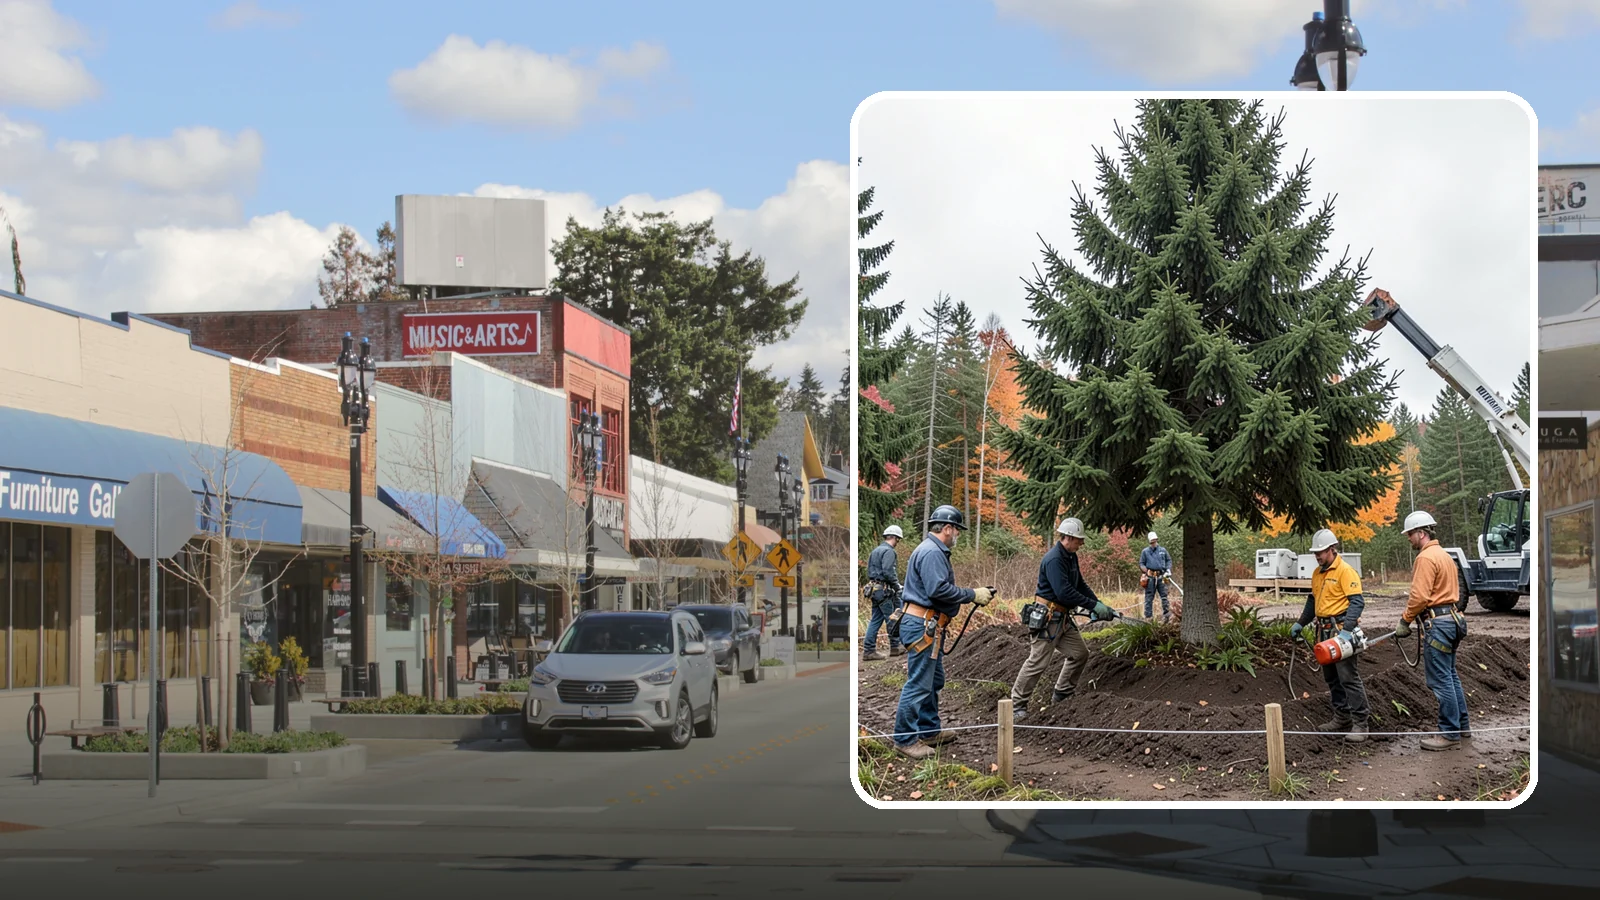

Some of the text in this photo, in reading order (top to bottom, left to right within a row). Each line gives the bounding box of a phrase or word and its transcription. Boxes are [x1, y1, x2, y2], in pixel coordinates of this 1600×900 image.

[1540, 427, 1578, 437] UGA
[0, 471, 121, 519] Furniture Gal
[453, 563, 479, 574] SUSHI
